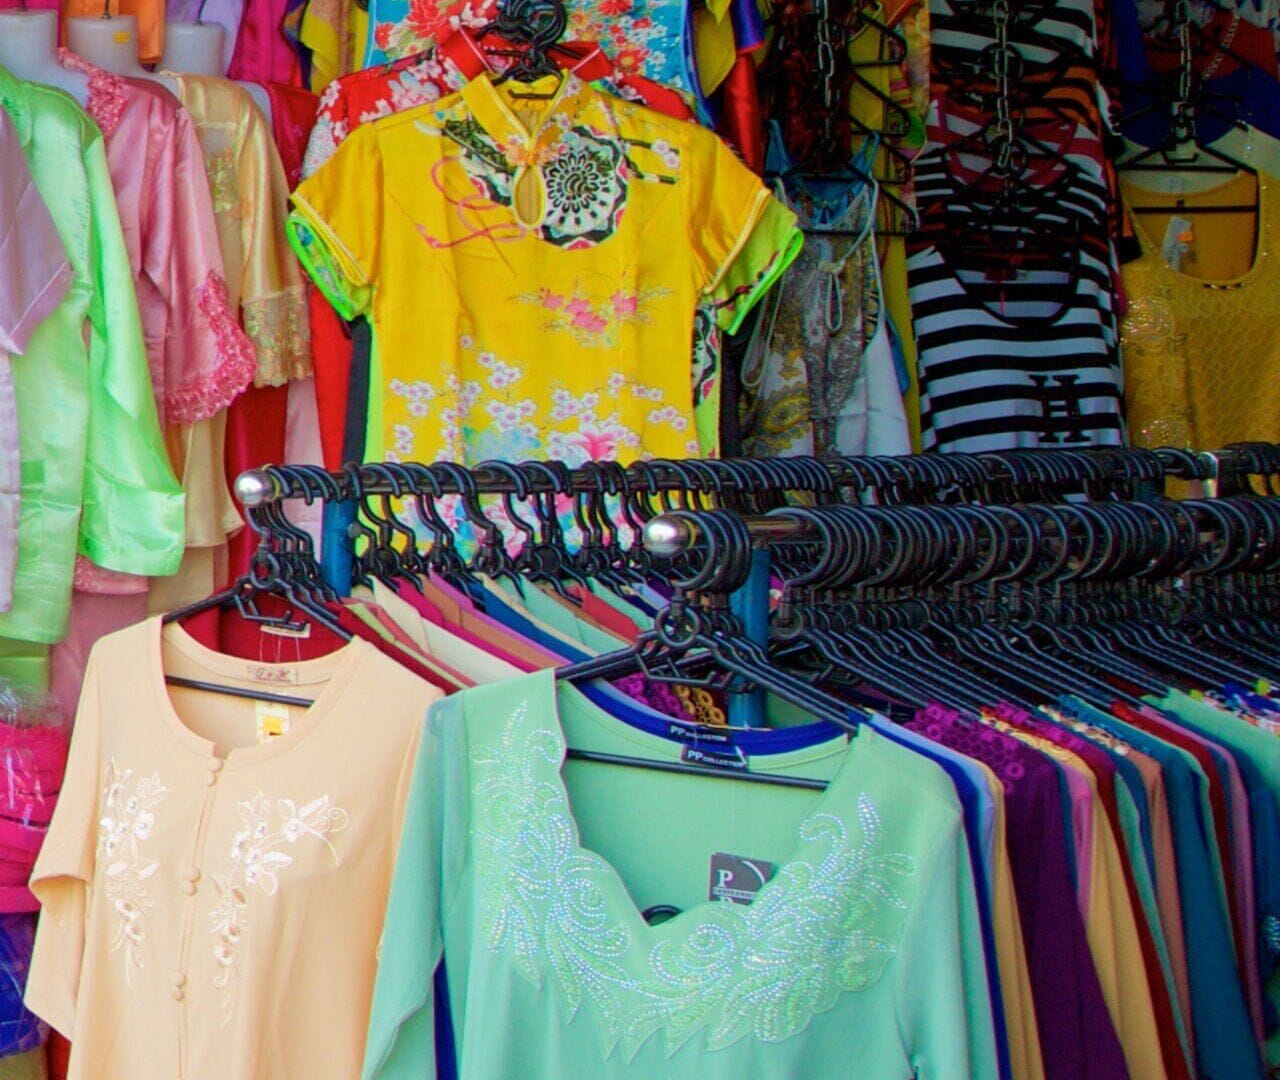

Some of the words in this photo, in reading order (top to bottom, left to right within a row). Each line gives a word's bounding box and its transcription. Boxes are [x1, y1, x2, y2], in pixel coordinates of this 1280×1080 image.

[1028, 374, 1091, 443] H
[670, 725, 686, 736] PP
[685, 731, 727, 742] COLLECTION
[687, 750, 704, 761] PP
[702, 757, 745, 768] COLLECTION
